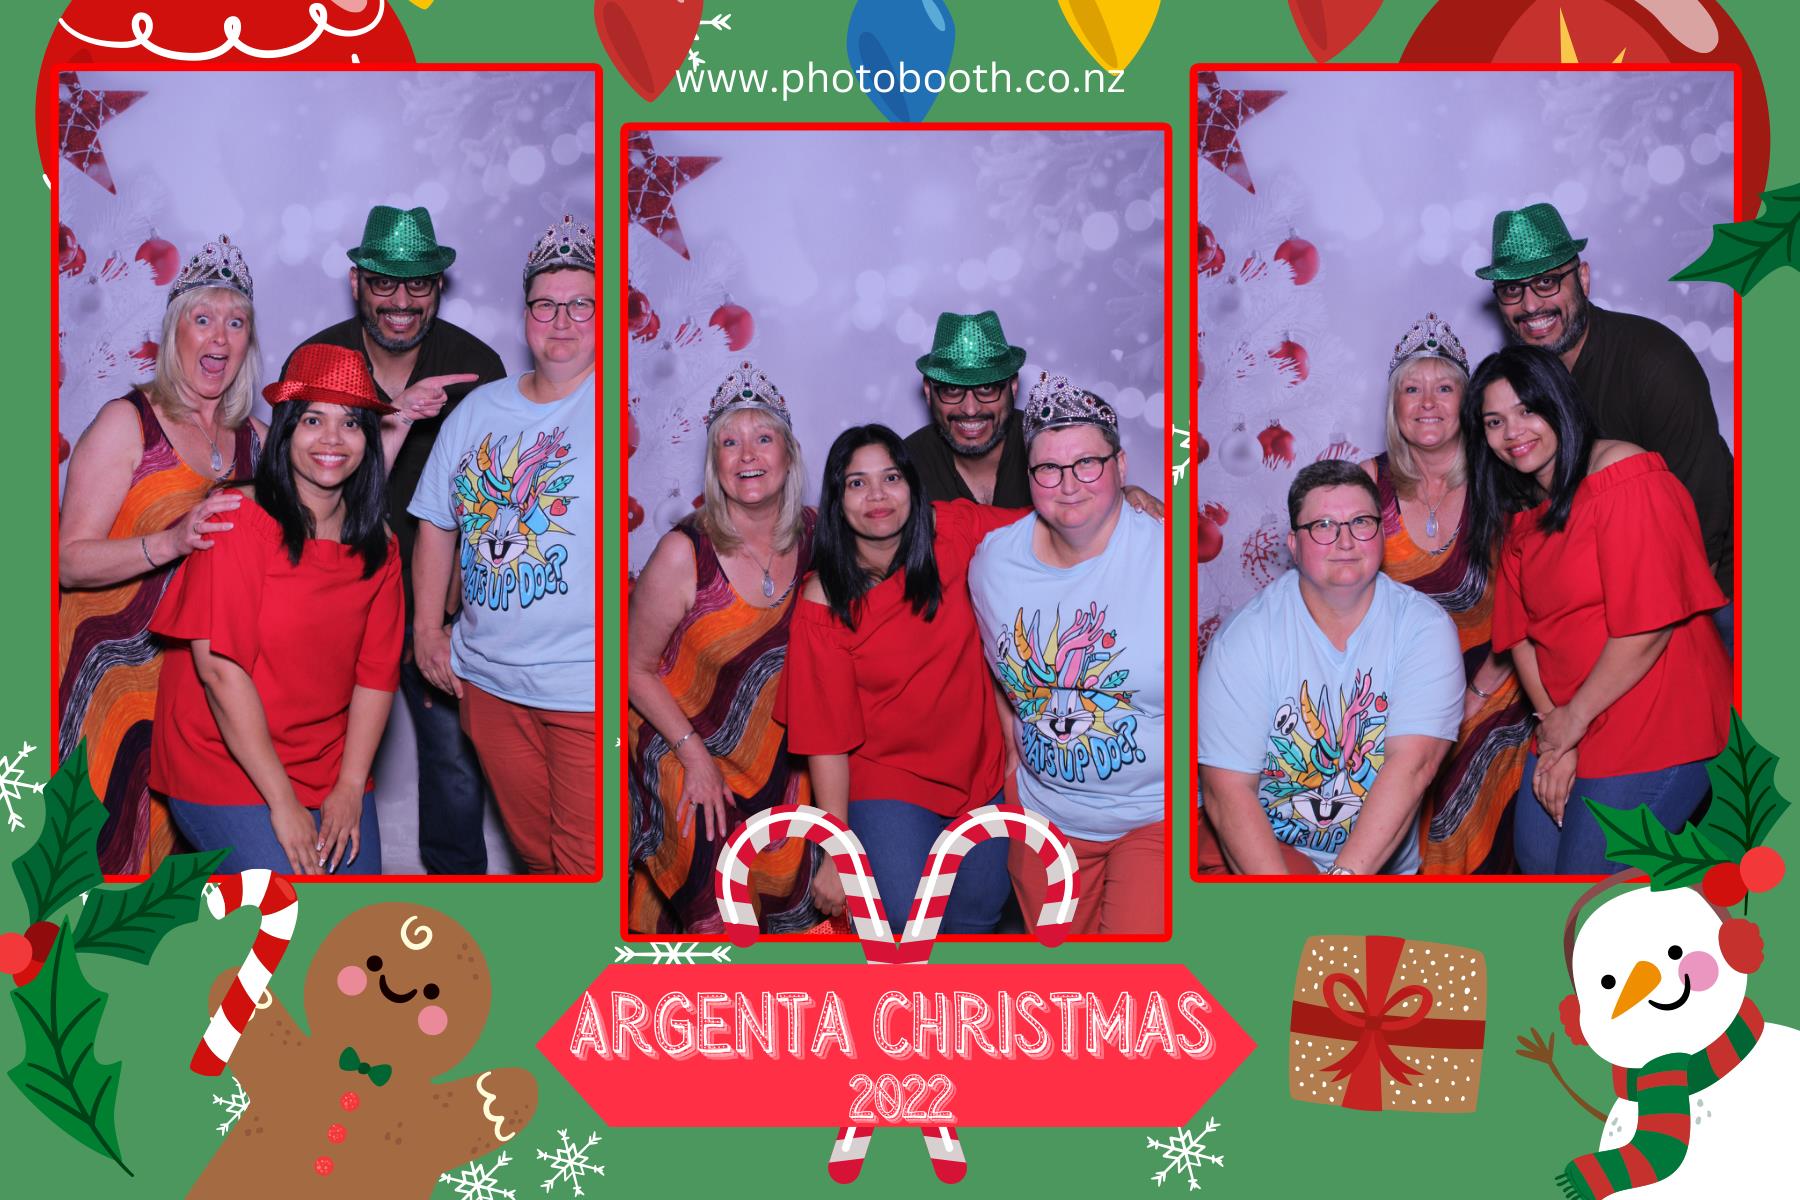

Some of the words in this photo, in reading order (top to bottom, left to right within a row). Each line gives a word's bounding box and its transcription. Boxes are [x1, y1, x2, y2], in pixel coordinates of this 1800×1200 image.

[487, 565, 517, 611] UP
[518, 544, 568, 609] DOC?
[1058, 742, 1089, 783] UP
[1089, 715, 1146, 780] DOC?
[1309, 826, 1348, 852] UP
